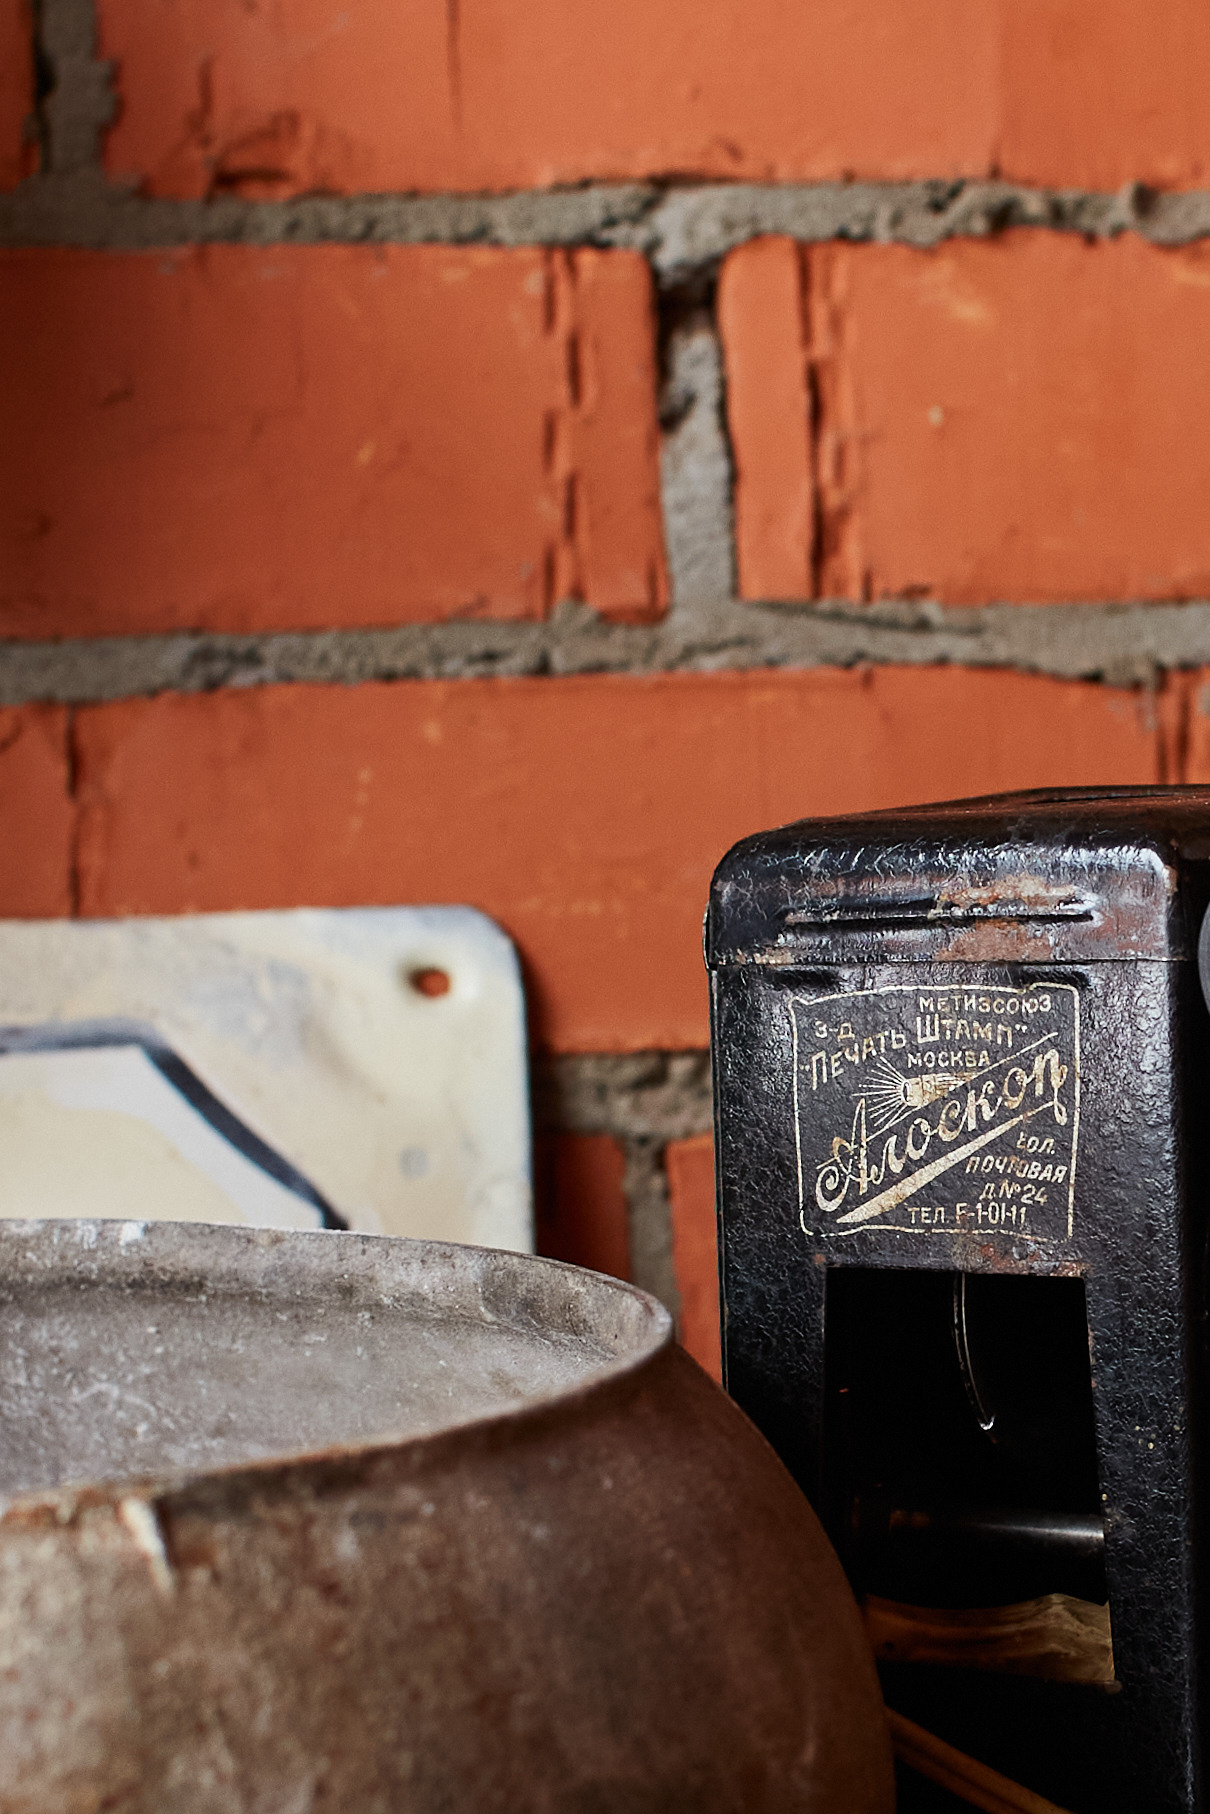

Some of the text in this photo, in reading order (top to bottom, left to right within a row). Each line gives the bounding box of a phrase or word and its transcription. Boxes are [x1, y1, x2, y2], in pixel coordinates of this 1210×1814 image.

[919, 994, 1051, 1014] МЕТИЗСОЮЗ
[907, 1050, 990, 1068] МОСКВА
[965, 1155, 1068, 1184] ПОЧТОВАЯ
